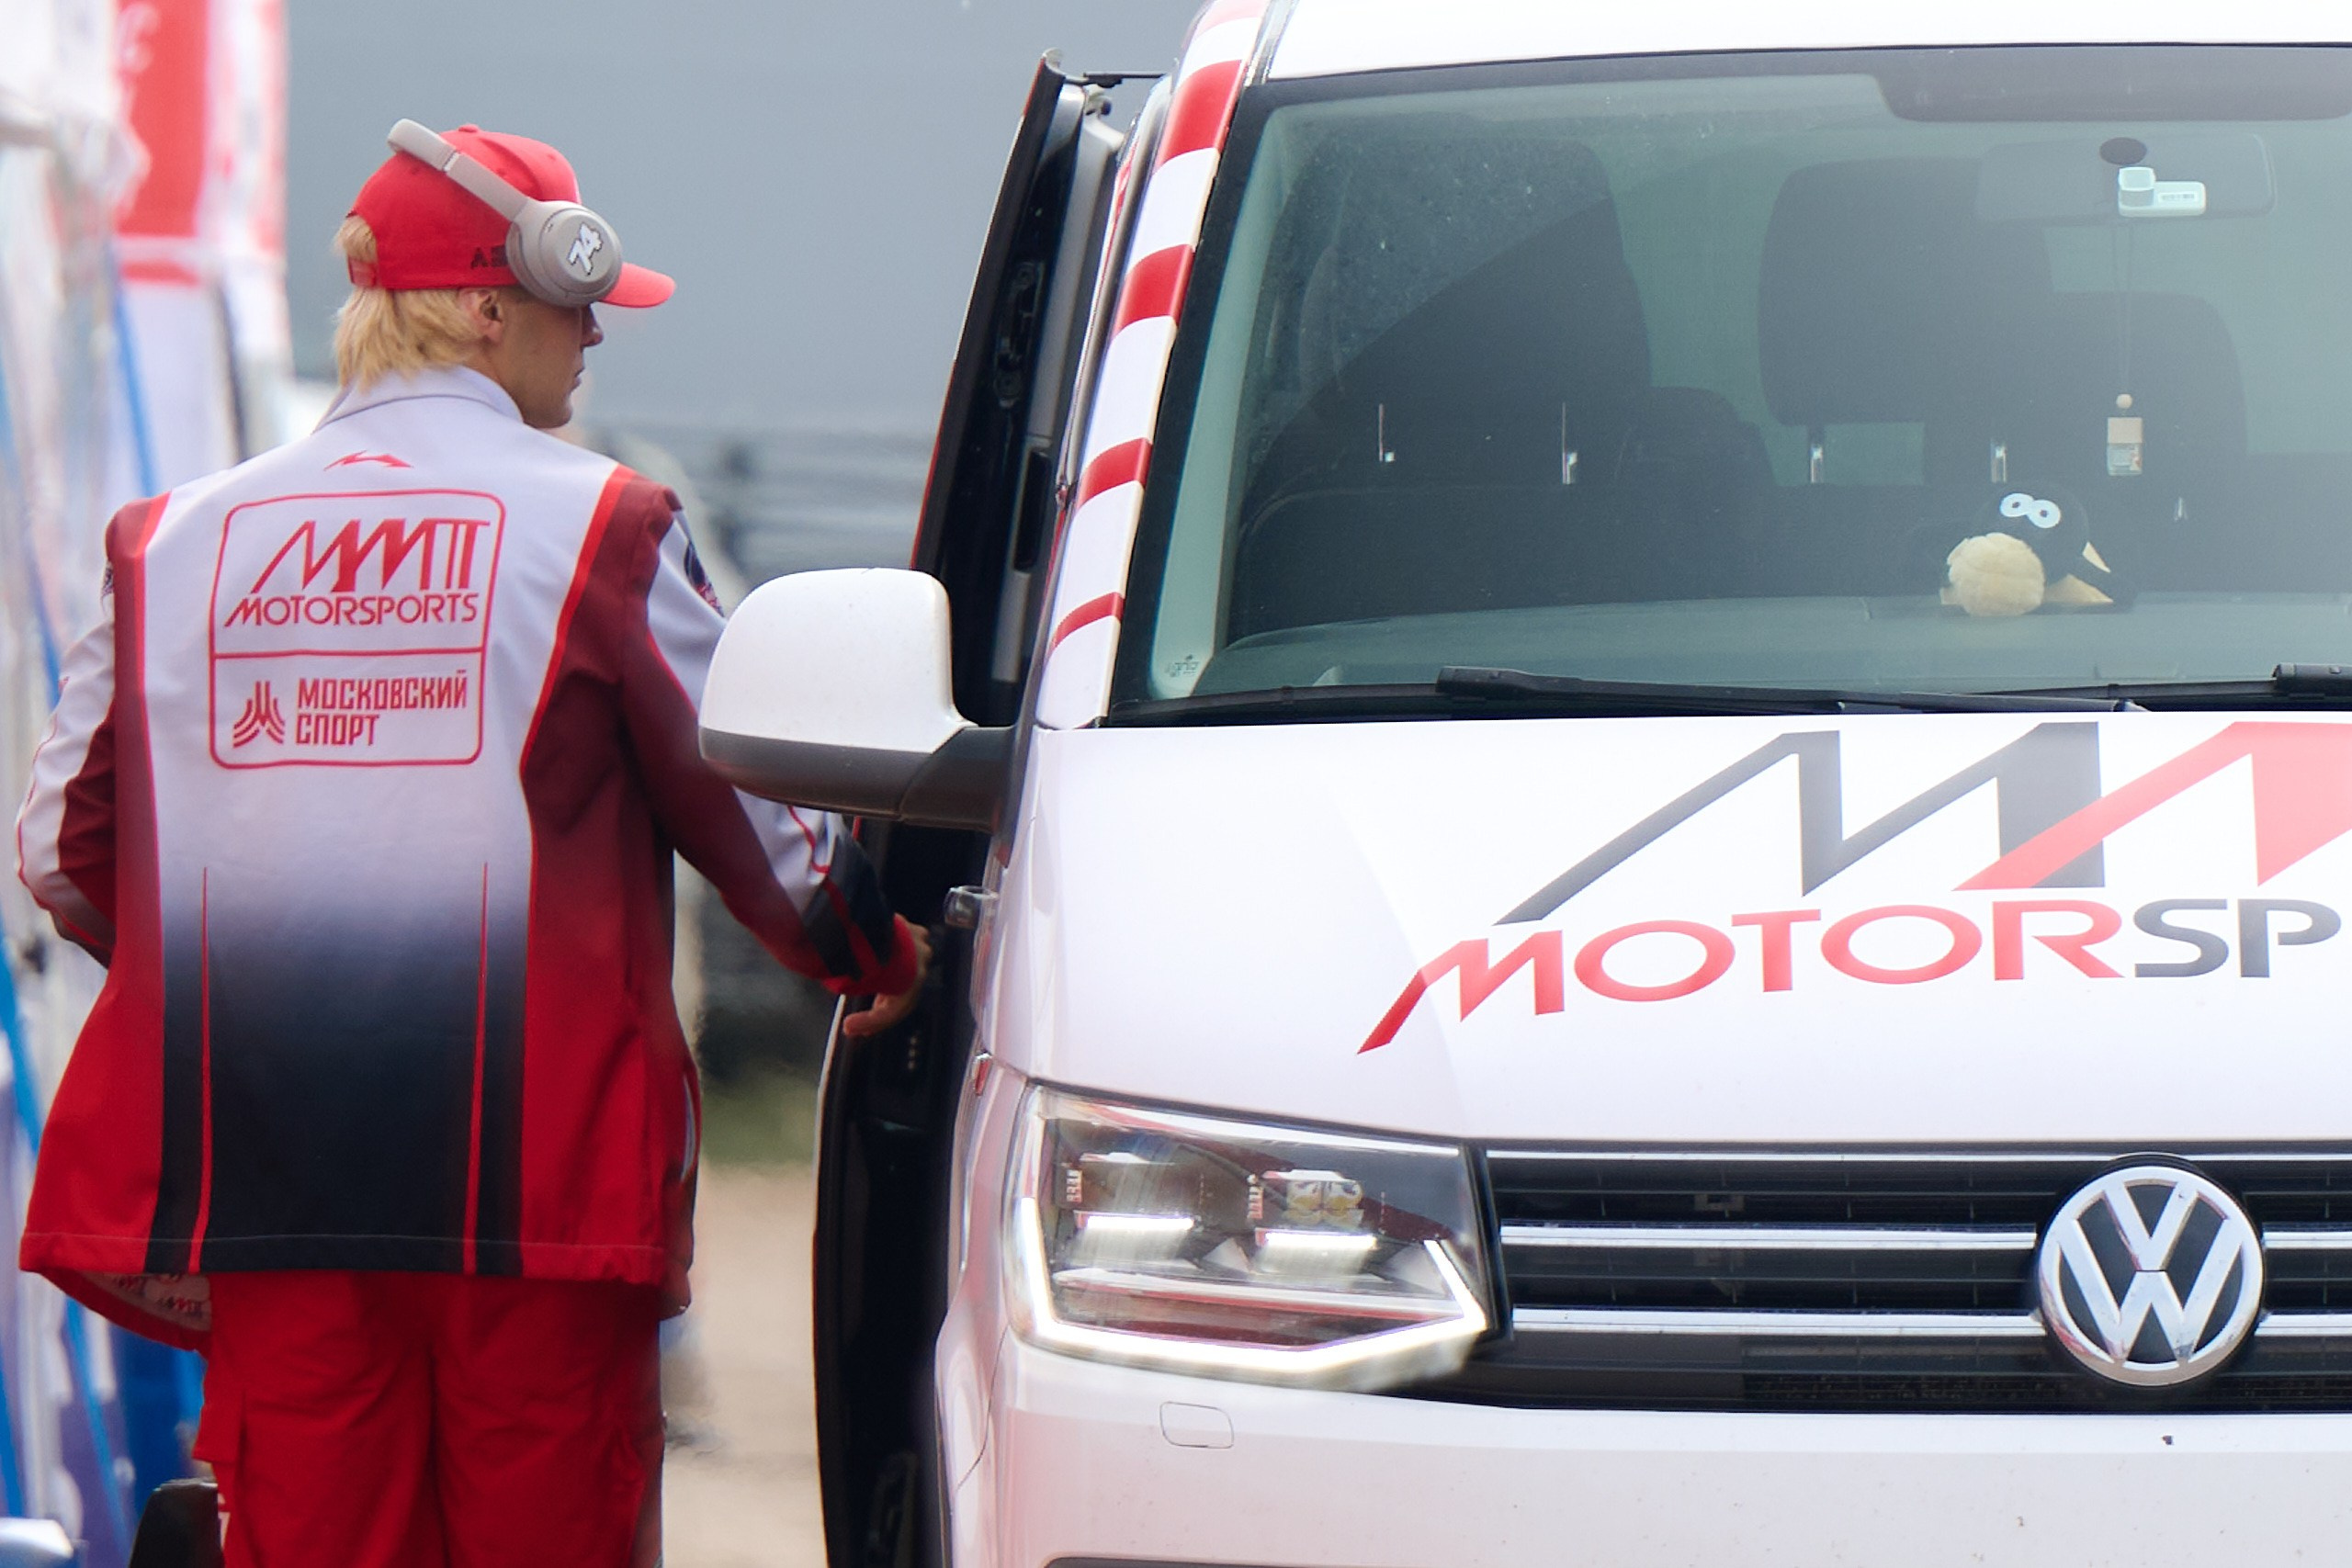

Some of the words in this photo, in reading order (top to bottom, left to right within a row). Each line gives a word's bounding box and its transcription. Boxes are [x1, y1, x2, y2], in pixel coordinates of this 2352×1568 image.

[224, 592, 480, 627] MOTORSPORTS
[297, 669, 468, 711] МОСКОВСКИЙ
[295, 714, 380, 746] СПОРТ
[1357, 897, 2342, 1055] MOTORSP
